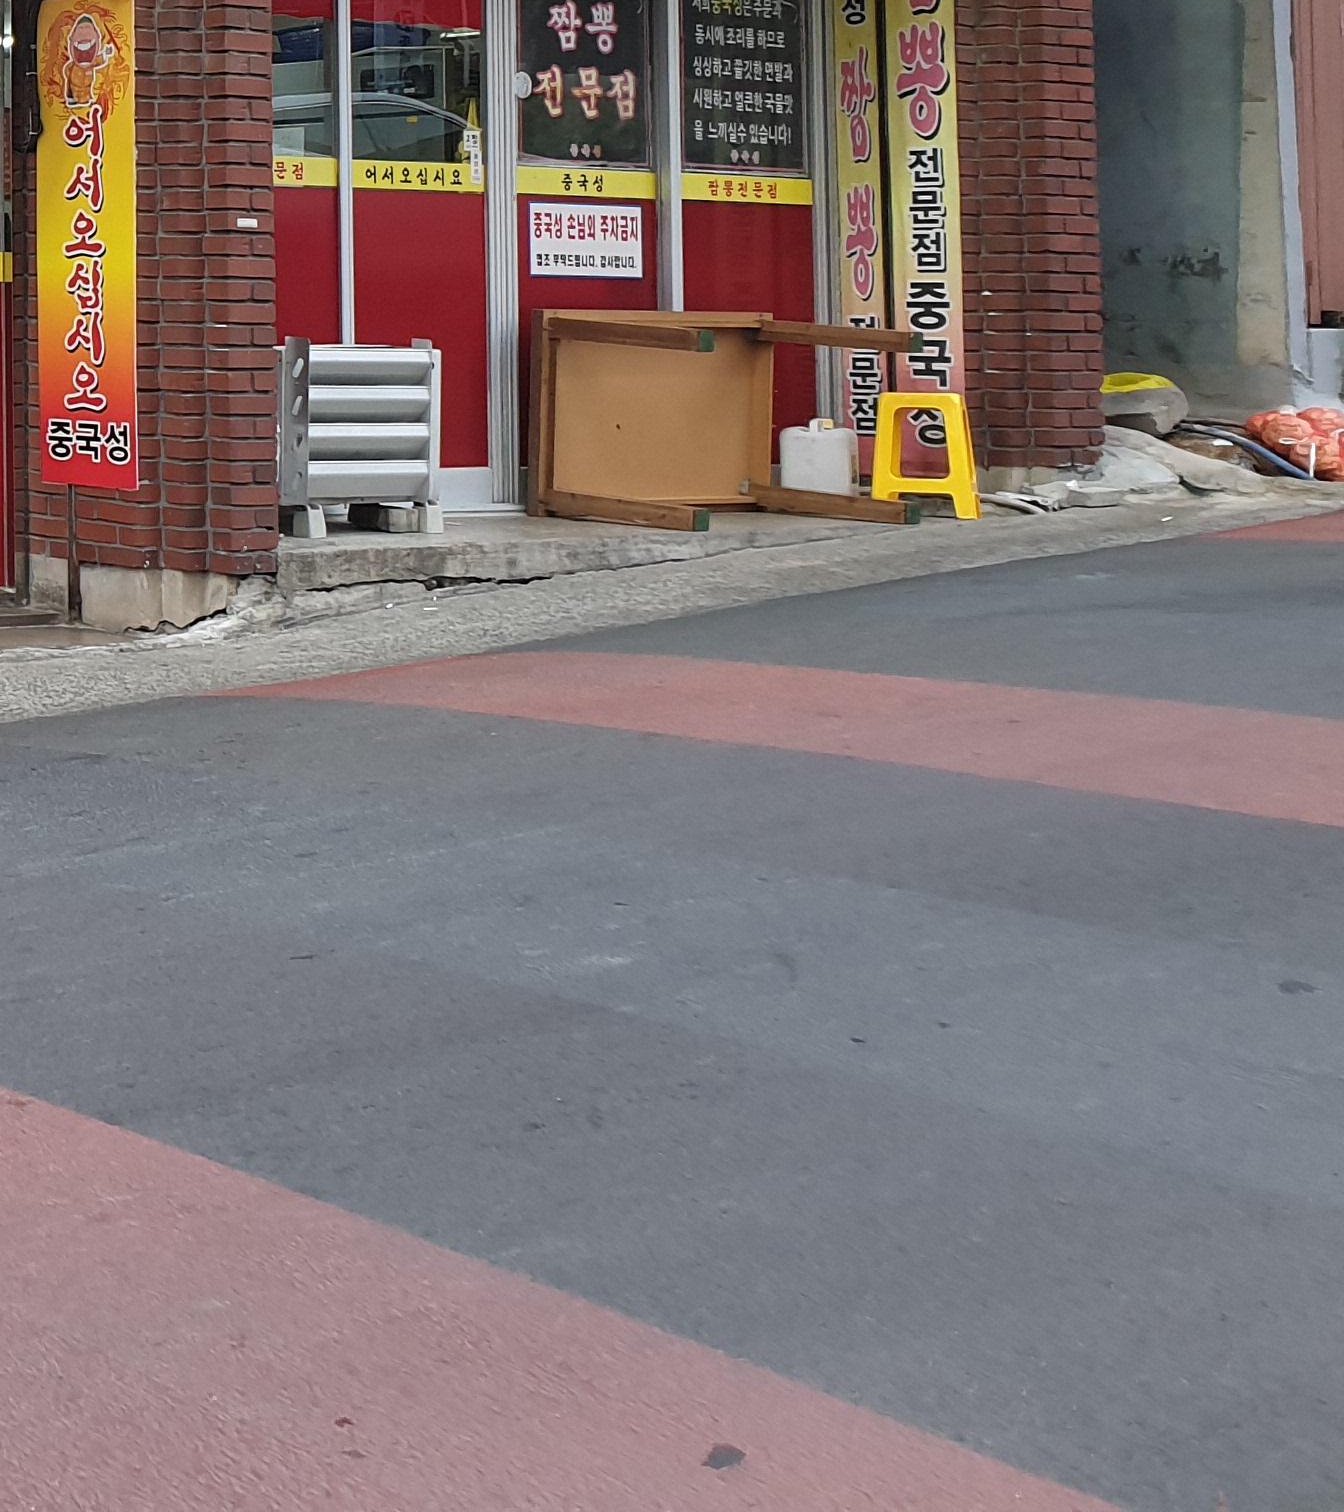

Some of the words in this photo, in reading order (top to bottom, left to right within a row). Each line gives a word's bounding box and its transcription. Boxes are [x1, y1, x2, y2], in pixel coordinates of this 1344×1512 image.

[547, 0, 618, 55] 짬뽕
[534, 64, 637, 120] 전문점
[365, 165, 462, 186] 어서오십시요
[561, 174, 604, 192] 중국성
[533, 212, 563, 240] 중국성
[567, 214, 596, 240] 손님외
[600, 215, 638, 241] 주차금지
[908, 147, 946, 272] 전문점
[63, 103, 106, 412] 어서오십시오
[46, 419, 131, 465] 중국성
